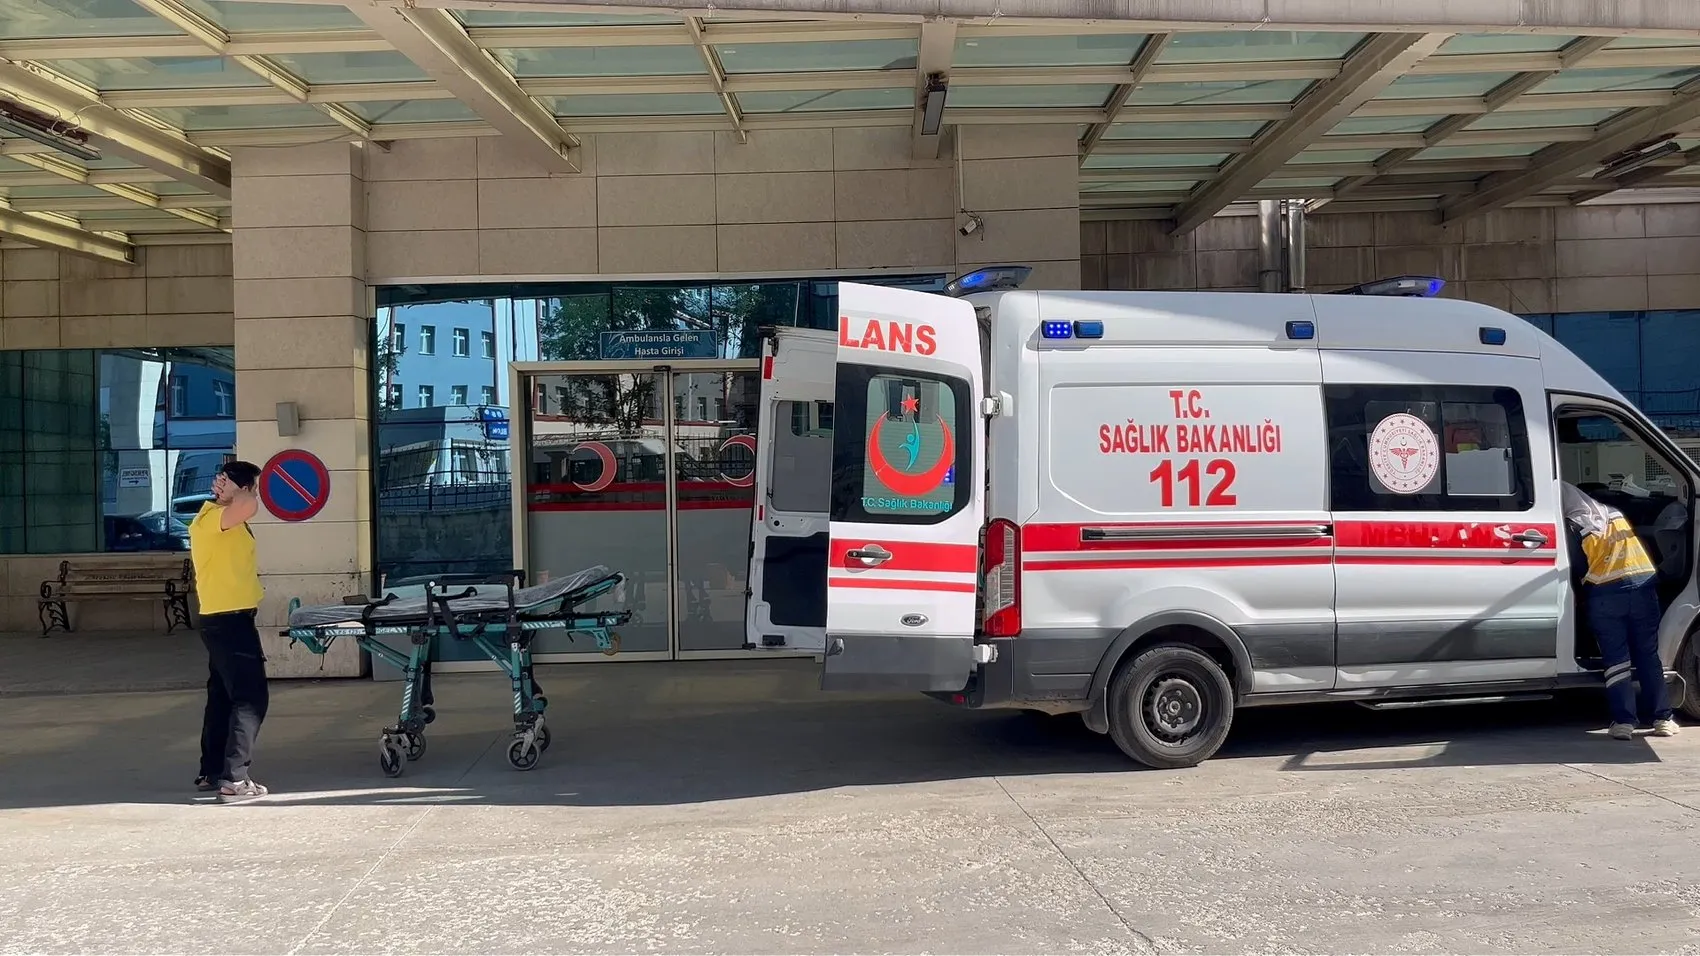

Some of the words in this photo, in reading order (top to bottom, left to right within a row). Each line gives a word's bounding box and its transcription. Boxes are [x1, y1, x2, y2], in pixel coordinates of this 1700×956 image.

[619, 333, 671, 343] Ambulansla
[673, 333, 699, 343] Gelen
[634, 347, 660, 355] Hasta
[661, 347, 684, 356] Girişi
[840, 317, 937, 356] LANS
[1169, 389, 1210, 419] T.C.
[1099, 418, 1171, 454] SAĞLIK
[1176, 418, 1282, 453] BAKANLIĞI
[1149, 458, 1237, 507] 112
[878, 497, 908, 510] Sağlık
[910, 499, 953, 512] Bakanlığı
